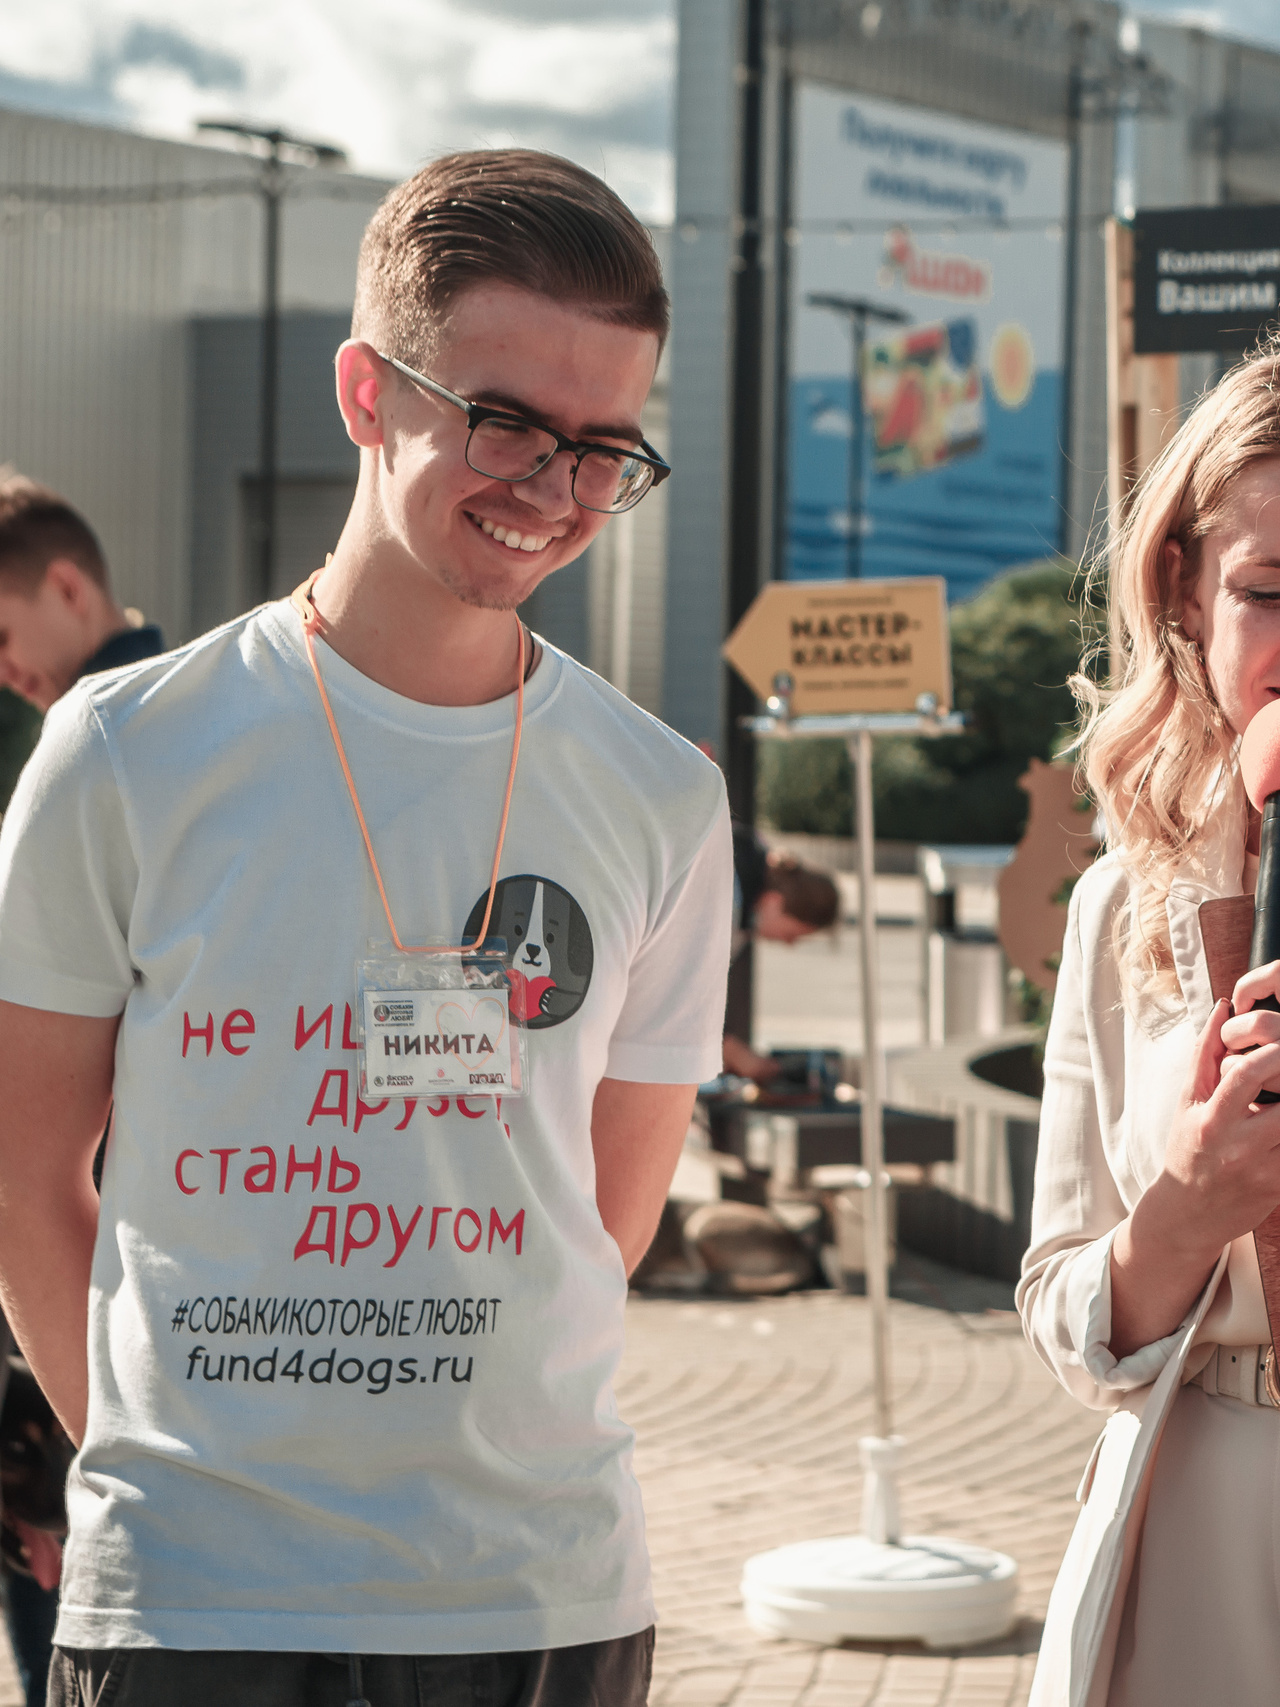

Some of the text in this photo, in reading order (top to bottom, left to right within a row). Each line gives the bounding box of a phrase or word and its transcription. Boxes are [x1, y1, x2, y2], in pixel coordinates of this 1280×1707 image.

[1157, 279, 1277, 314] Вашим
[792, 642, 913, 668] КЛАССЫ
[182, 1008, 256, 1058] не
[383, 1033, 495, 1056] НИКИТА
[175, 1144, 361, 1195] стань
[294, 1202, 526, 1268] другом
[186, 1346, 474, 1395] fund4dogs.ru
